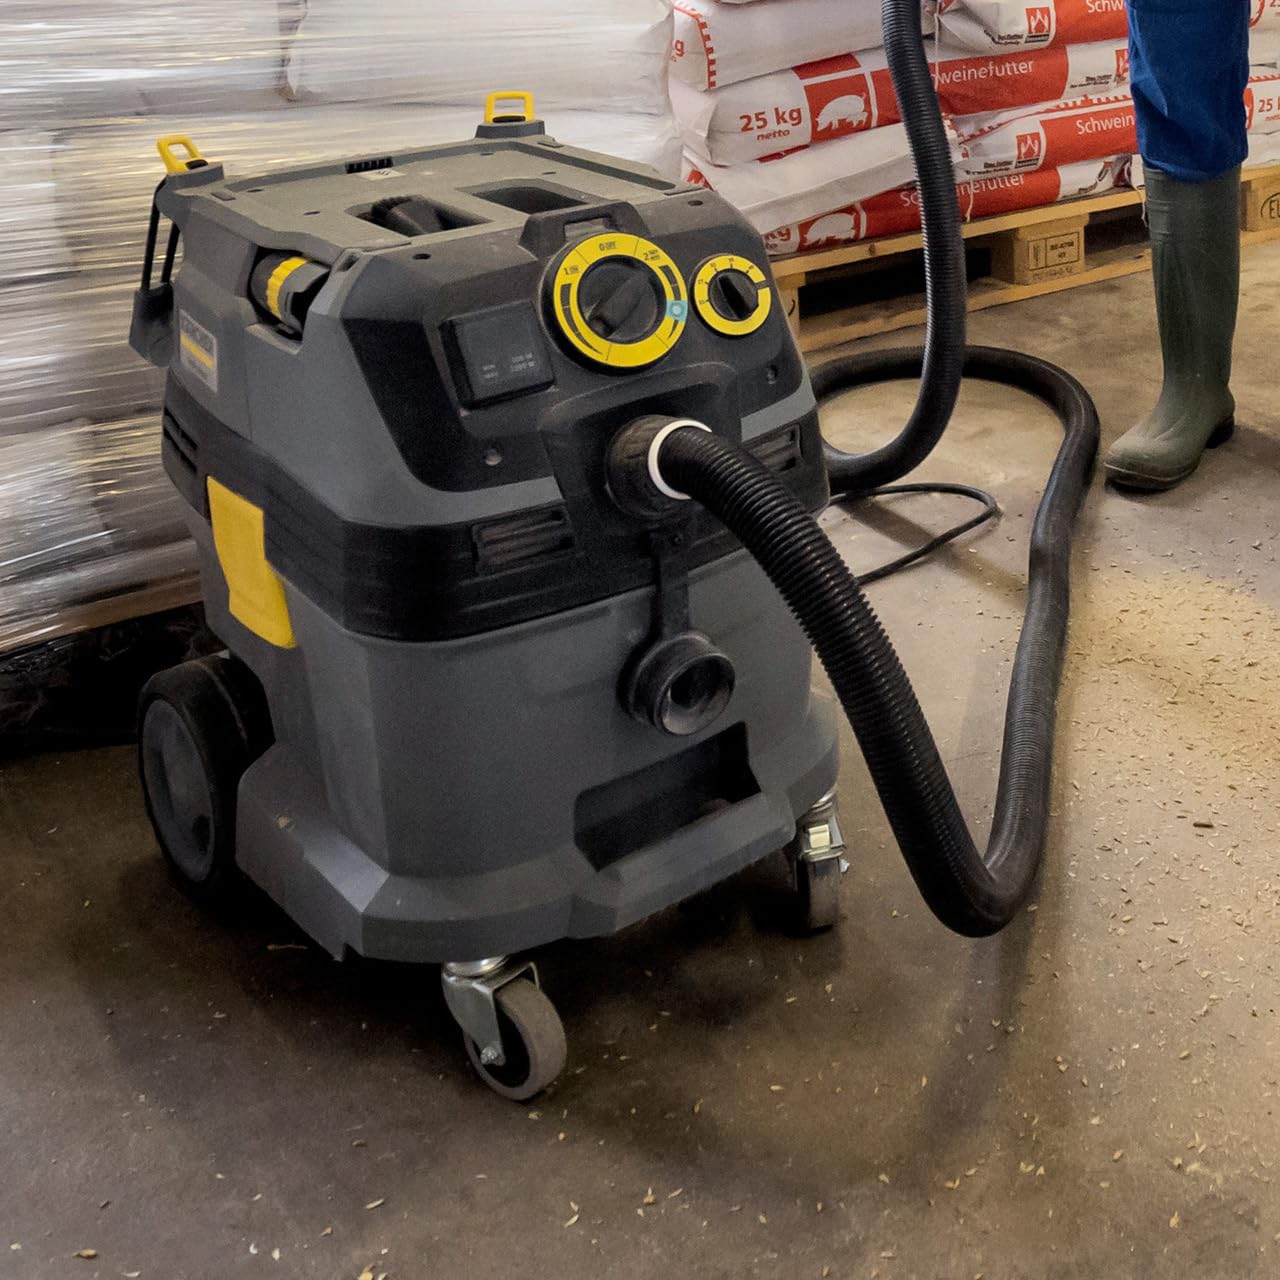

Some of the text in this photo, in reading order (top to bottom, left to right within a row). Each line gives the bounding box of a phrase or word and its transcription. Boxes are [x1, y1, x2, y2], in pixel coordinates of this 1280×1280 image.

[675, 39, 684, 57] g
[930, 61, 1034, 85] weinefutter
[1258, 98, 1273, 113] 25
[739, 106, 803, 133] 25 kg
[1076, 112, 1135, 134] Schwein
[756, 128, 790, 141] netto
[900, 173, 1025, 207] Scnefutter
